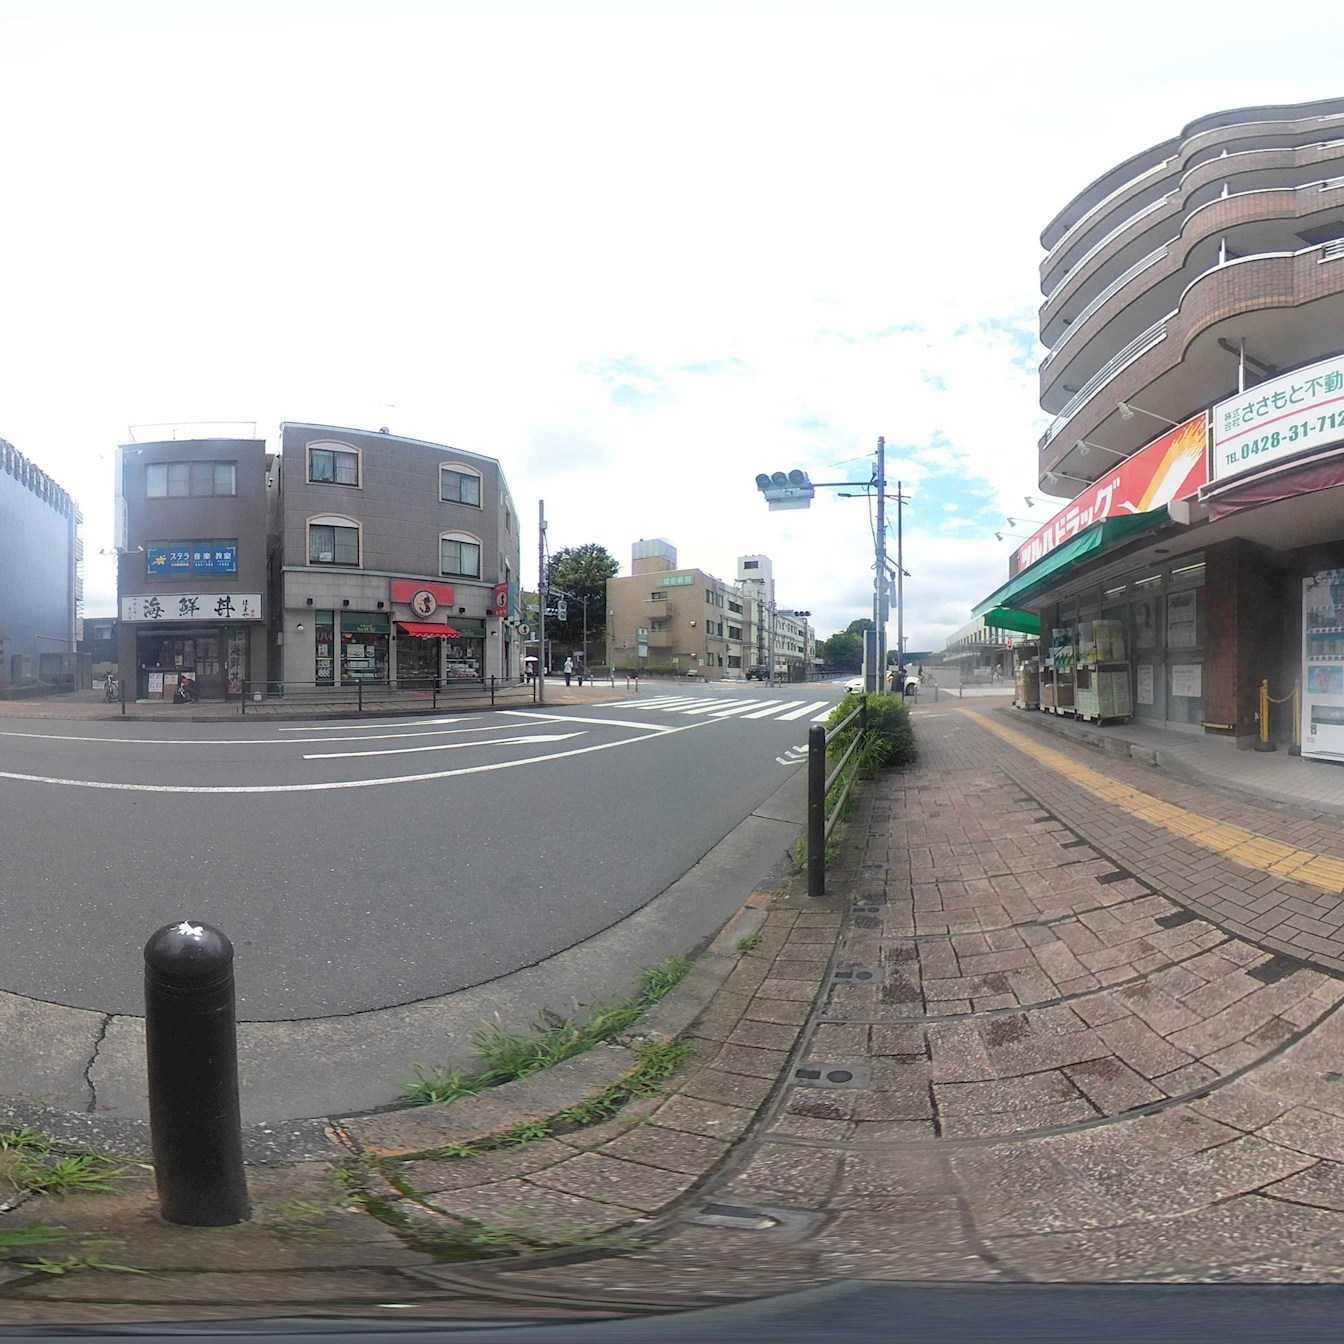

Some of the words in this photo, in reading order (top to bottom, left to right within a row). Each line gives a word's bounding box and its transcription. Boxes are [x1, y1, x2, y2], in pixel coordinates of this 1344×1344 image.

[1021, 476, 1120, 568] ツルハドラッグ
[143, 595, 236, 618] 海鮮丼
